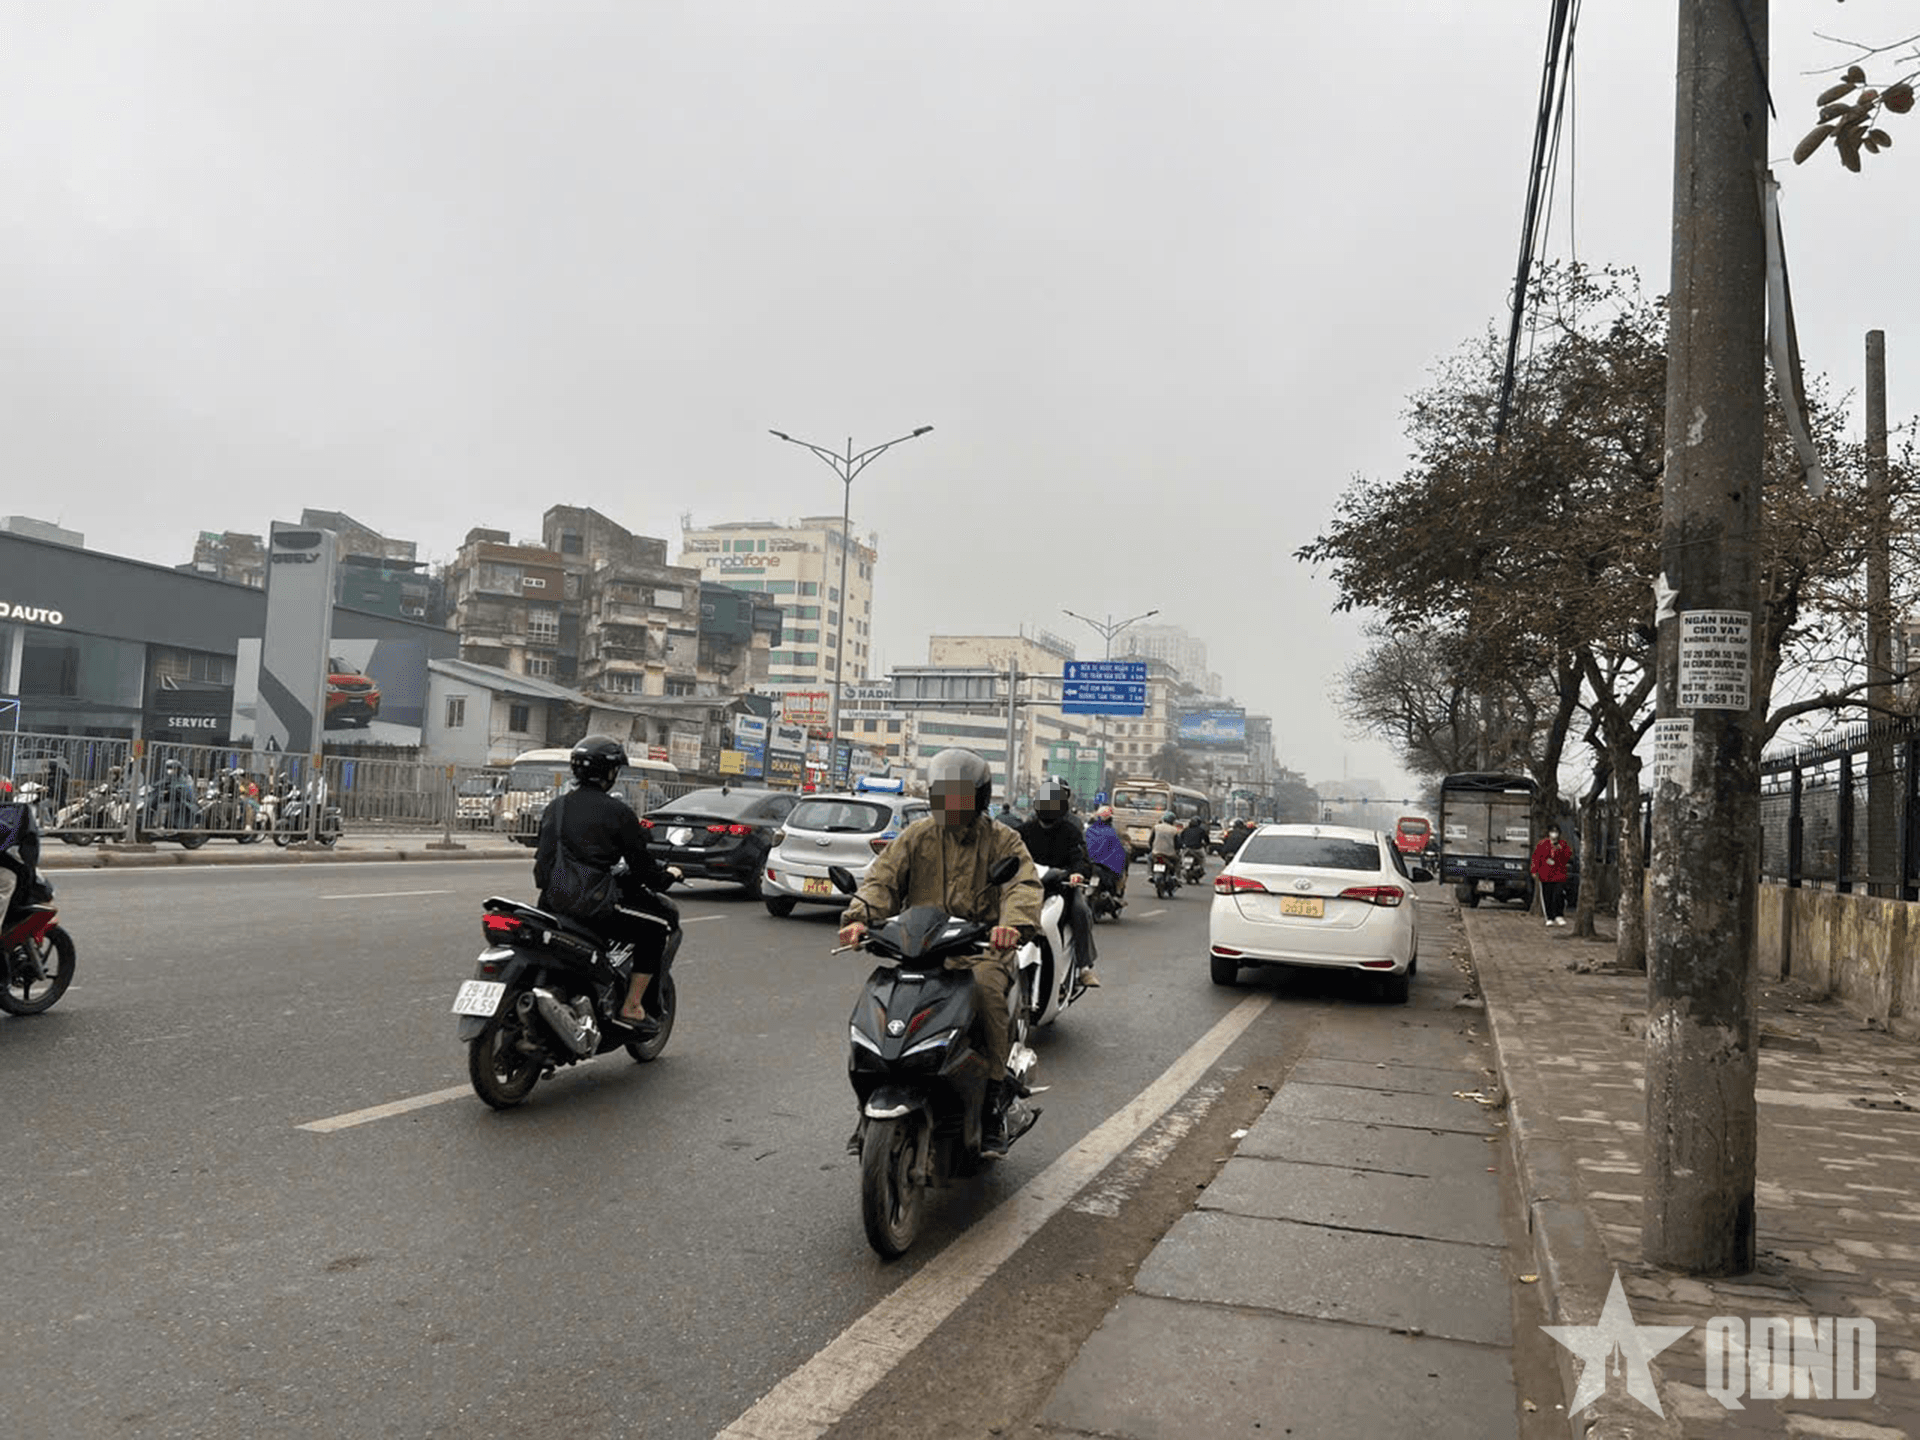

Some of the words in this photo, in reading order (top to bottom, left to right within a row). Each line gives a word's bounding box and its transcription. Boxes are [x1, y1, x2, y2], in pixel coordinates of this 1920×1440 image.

[706, 553, 781, 568] mobifone
[11, 605, 63, 625] AUTO
[1693, 626, 1717, 634] CHO
[1720, 626, 1741, 635] VAY
[1682, 694, 1699, 704] 037
[1730, 694, 1745, 705] 123
[168, 716, 217, 729] SERVICE
[1663, 733, 1681, 741] VAY
